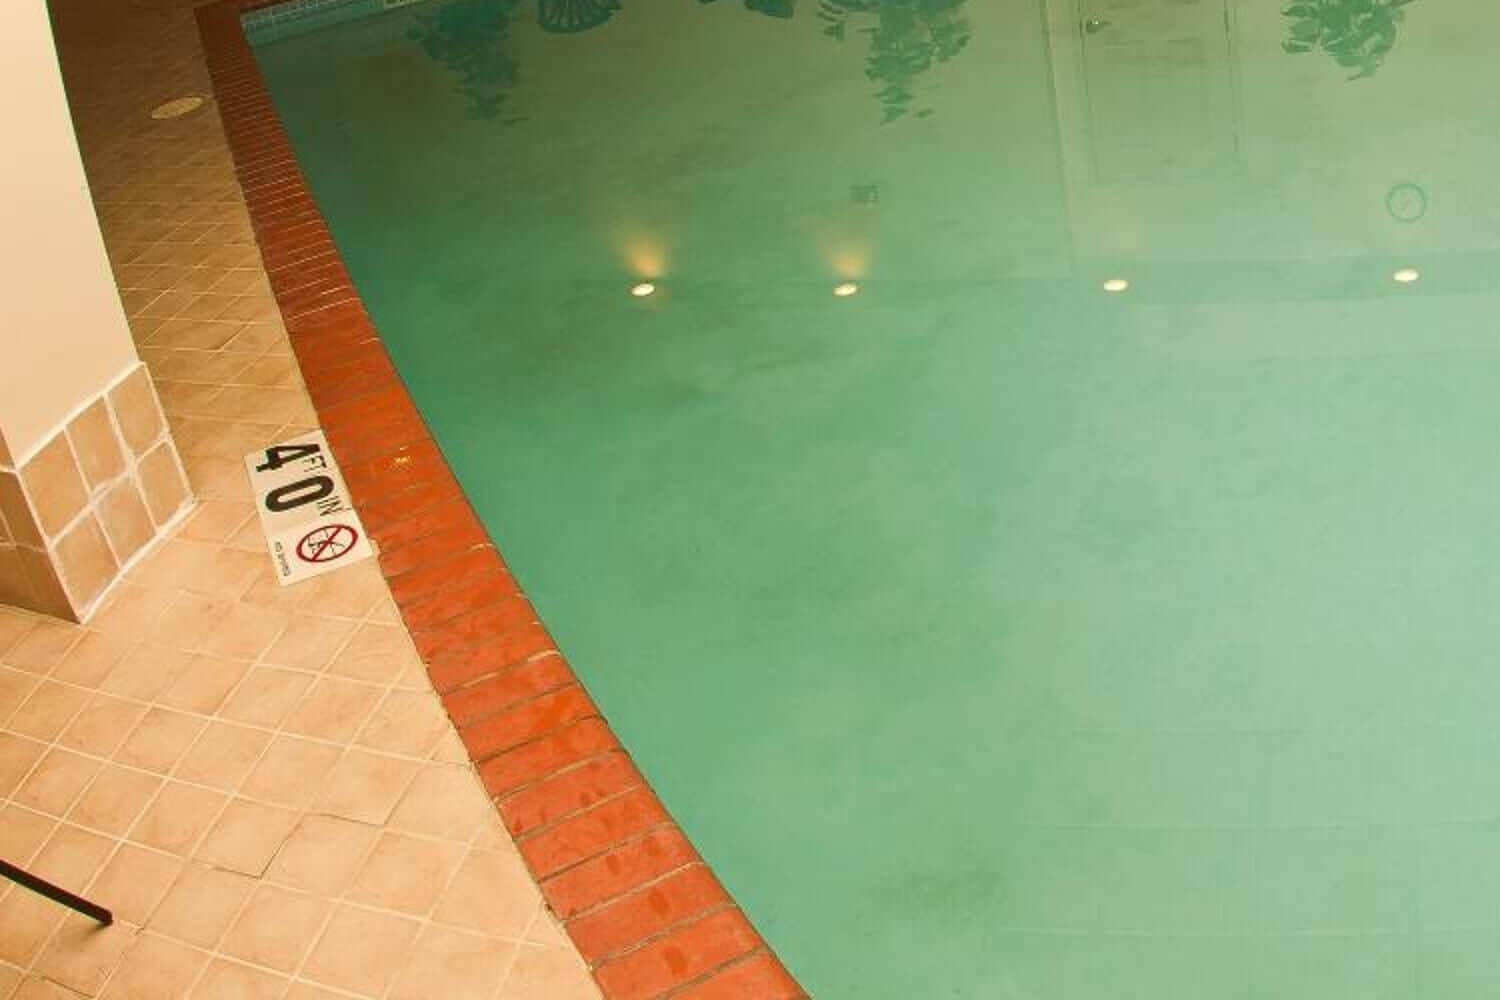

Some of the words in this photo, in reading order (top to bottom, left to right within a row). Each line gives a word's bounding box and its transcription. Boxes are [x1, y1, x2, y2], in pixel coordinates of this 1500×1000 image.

[256, 443, 321, 472] 4
[301, 455, 328, 474] FT
[265, 475, 334, 512] 0
[316, 495, 352, 517] IN
